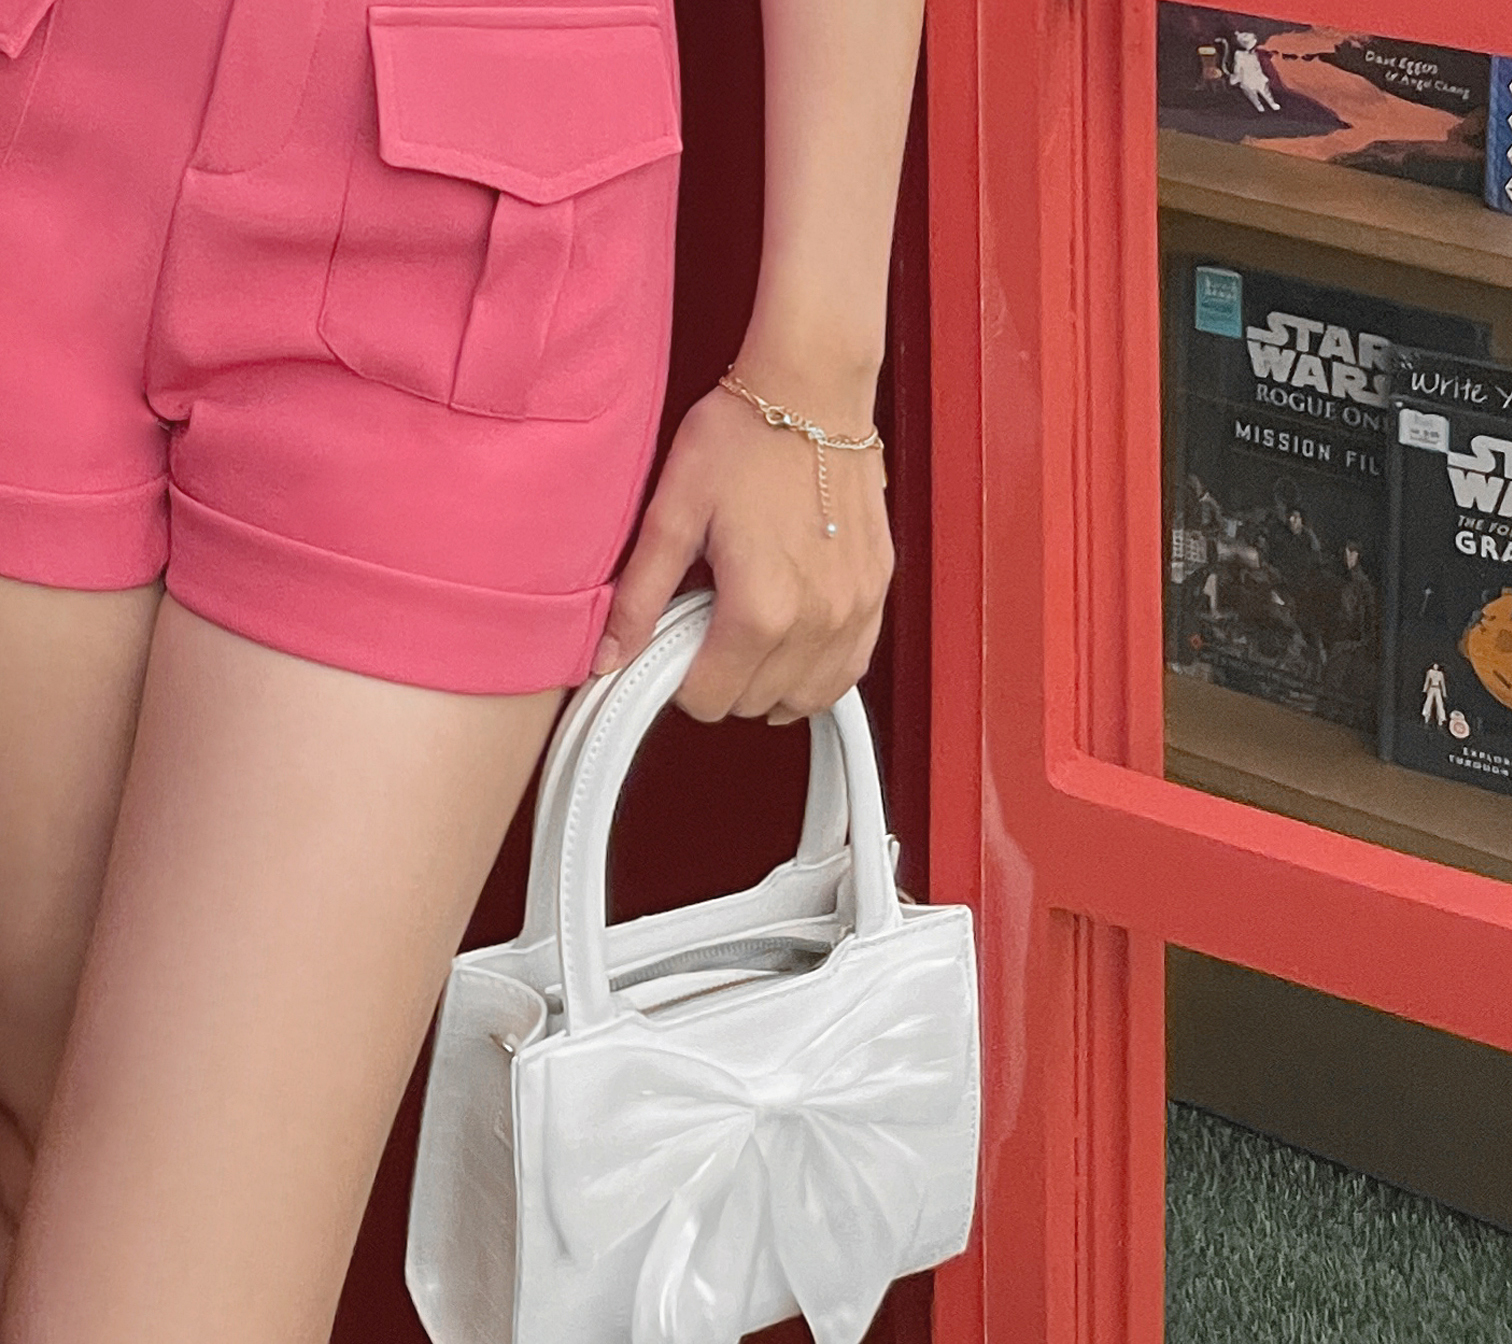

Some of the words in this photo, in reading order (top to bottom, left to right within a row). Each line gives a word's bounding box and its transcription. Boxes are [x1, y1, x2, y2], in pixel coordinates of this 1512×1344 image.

[1246, 311, 1391, 371] STAR
[1256, 383, 1337, 420] ROGUE
[1411, 372, 1488, 404] Write
[1494, 385, 1512, 409] Y
[1235, 420, 1331, 462] MISSION
[1345, 450, 1380, 476] FIL
[1447, 435, 1512, 480] ST
[1447, 467, 1512, 518] W
[1455, 530, 1512, 563] GRA
[1458, 515, 1485, 531] THE
[1487, 522, 1512, 539] FO
